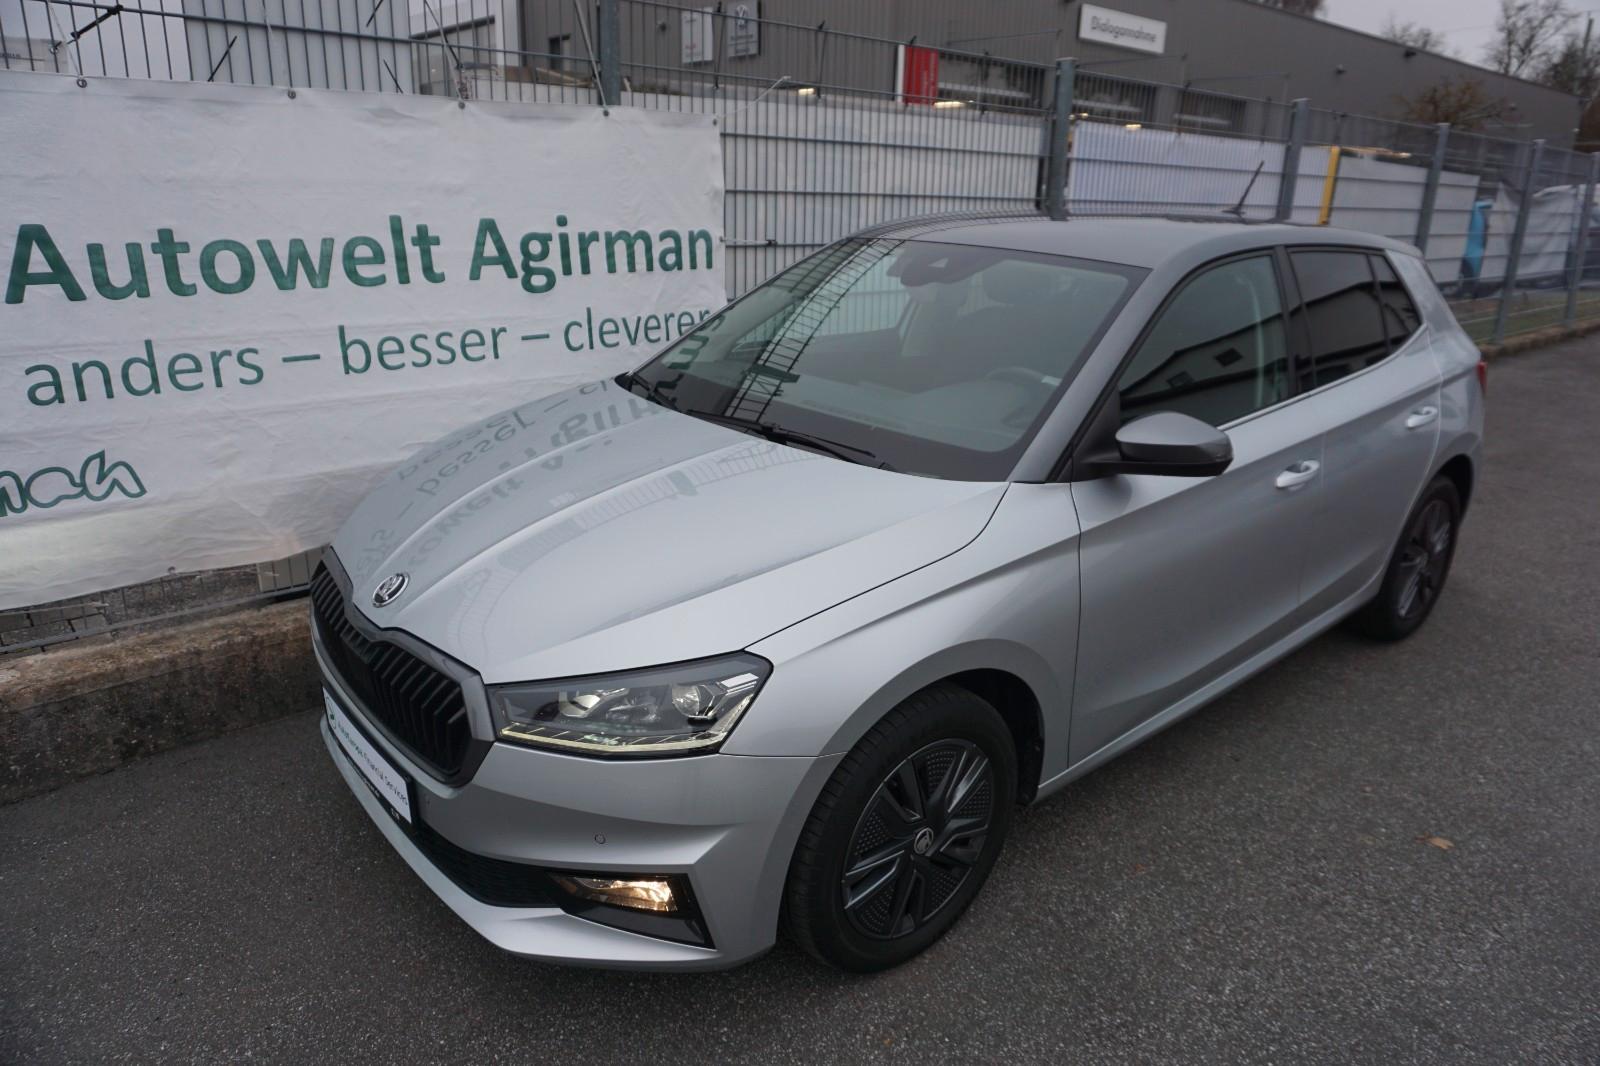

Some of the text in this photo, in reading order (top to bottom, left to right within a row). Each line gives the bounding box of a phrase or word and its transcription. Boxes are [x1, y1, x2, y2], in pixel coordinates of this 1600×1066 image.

[4, 214, 714, 305] Autowelt Agirman
[24, 338, 265, 407] anders
[337, 324, 508, 375] besser
